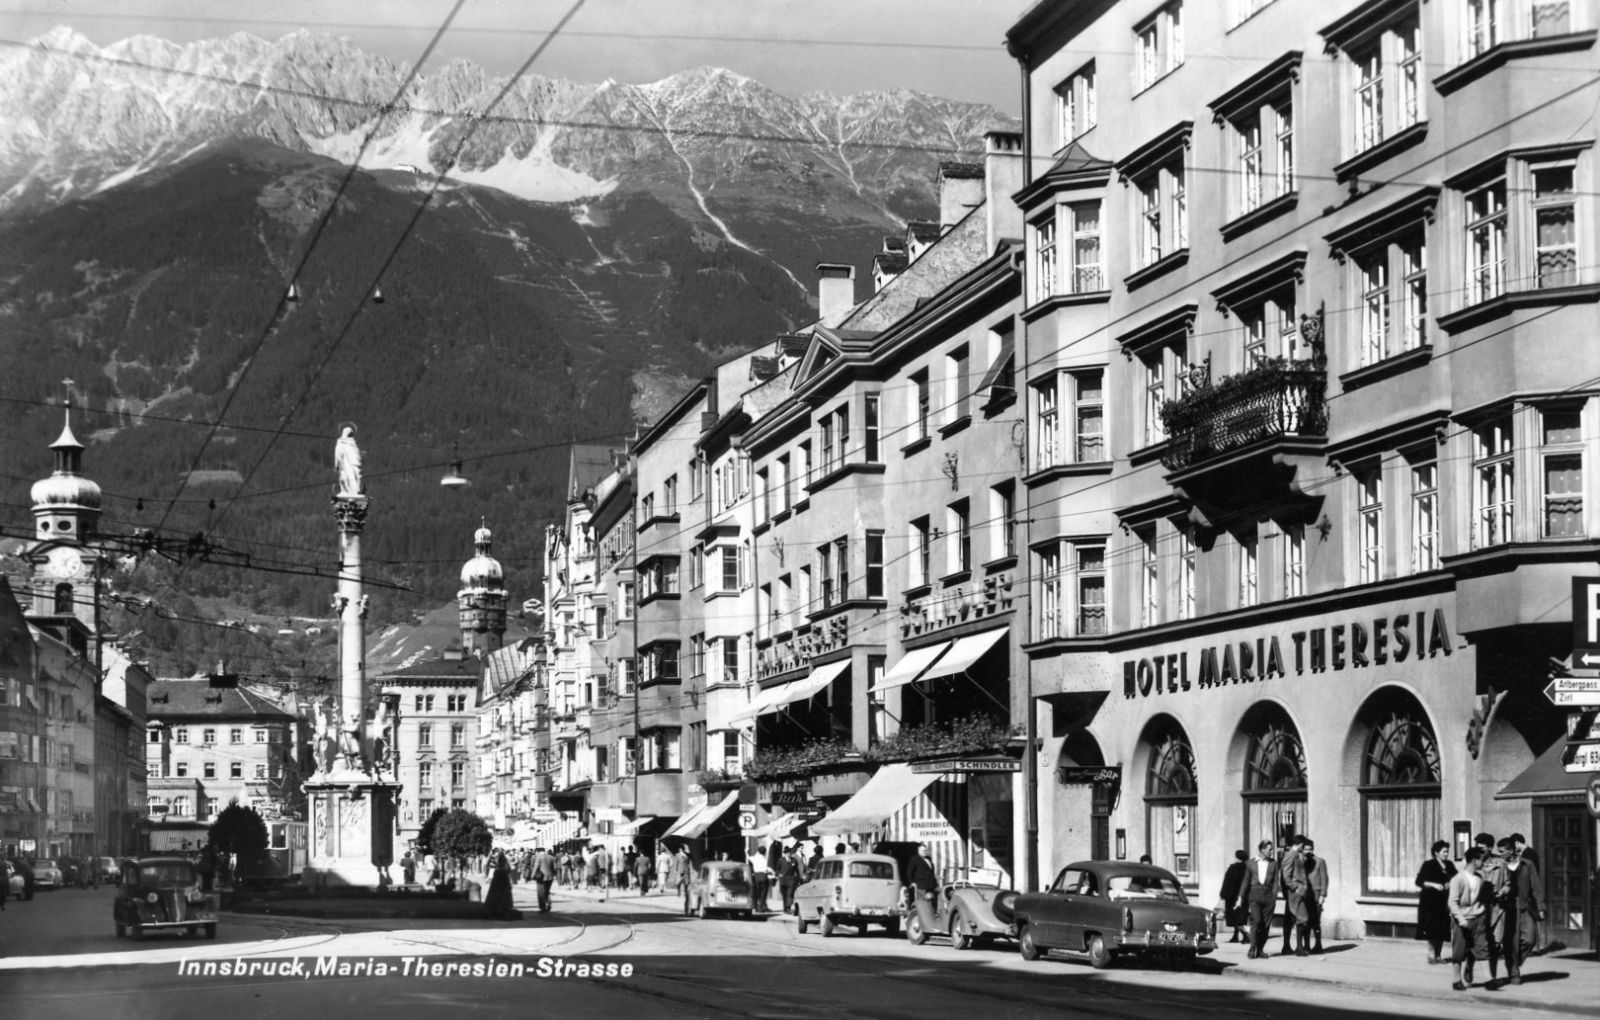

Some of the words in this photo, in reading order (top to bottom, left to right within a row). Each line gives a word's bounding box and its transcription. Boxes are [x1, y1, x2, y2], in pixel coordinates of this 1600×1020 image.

[1123, 652, 1191, 699] HOTEL
[1198, 636, 1286, 690] MARIA
[1292, 608, 1453, 677] THERESIA
[1559, 680, 1598, 691] Arlbergpass
[1559, 693, 1573, 702] Zirl
[1093, 769, 1119, 780] Bar
